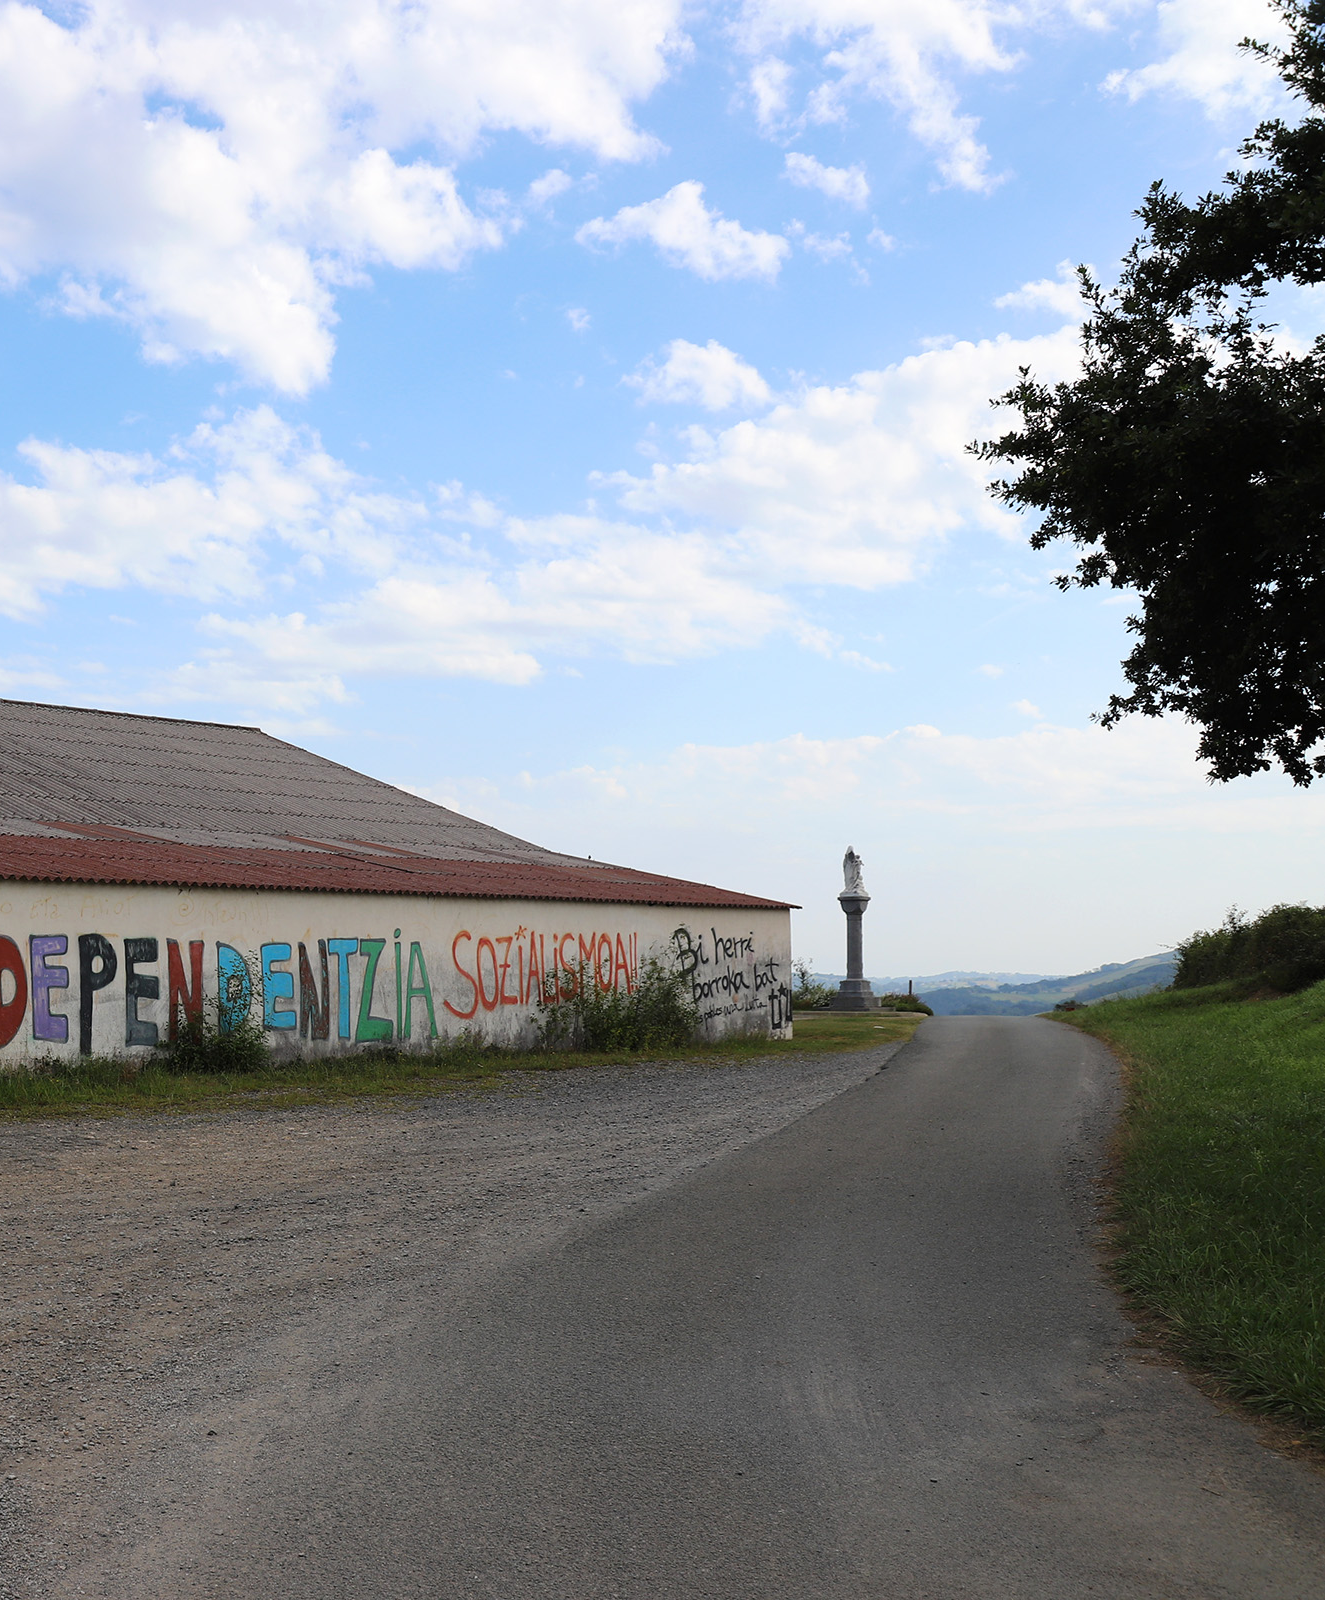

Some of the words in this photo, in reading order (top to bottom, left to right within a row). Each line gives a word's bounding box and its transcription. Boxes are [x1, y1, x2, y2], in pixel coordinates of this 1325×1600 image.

[672, 927, 709, 978] Bi
[710, 927, 754, 966] herri
[692, 965, 750, 1002] borroka
[753, 957, 779, 992] bat
